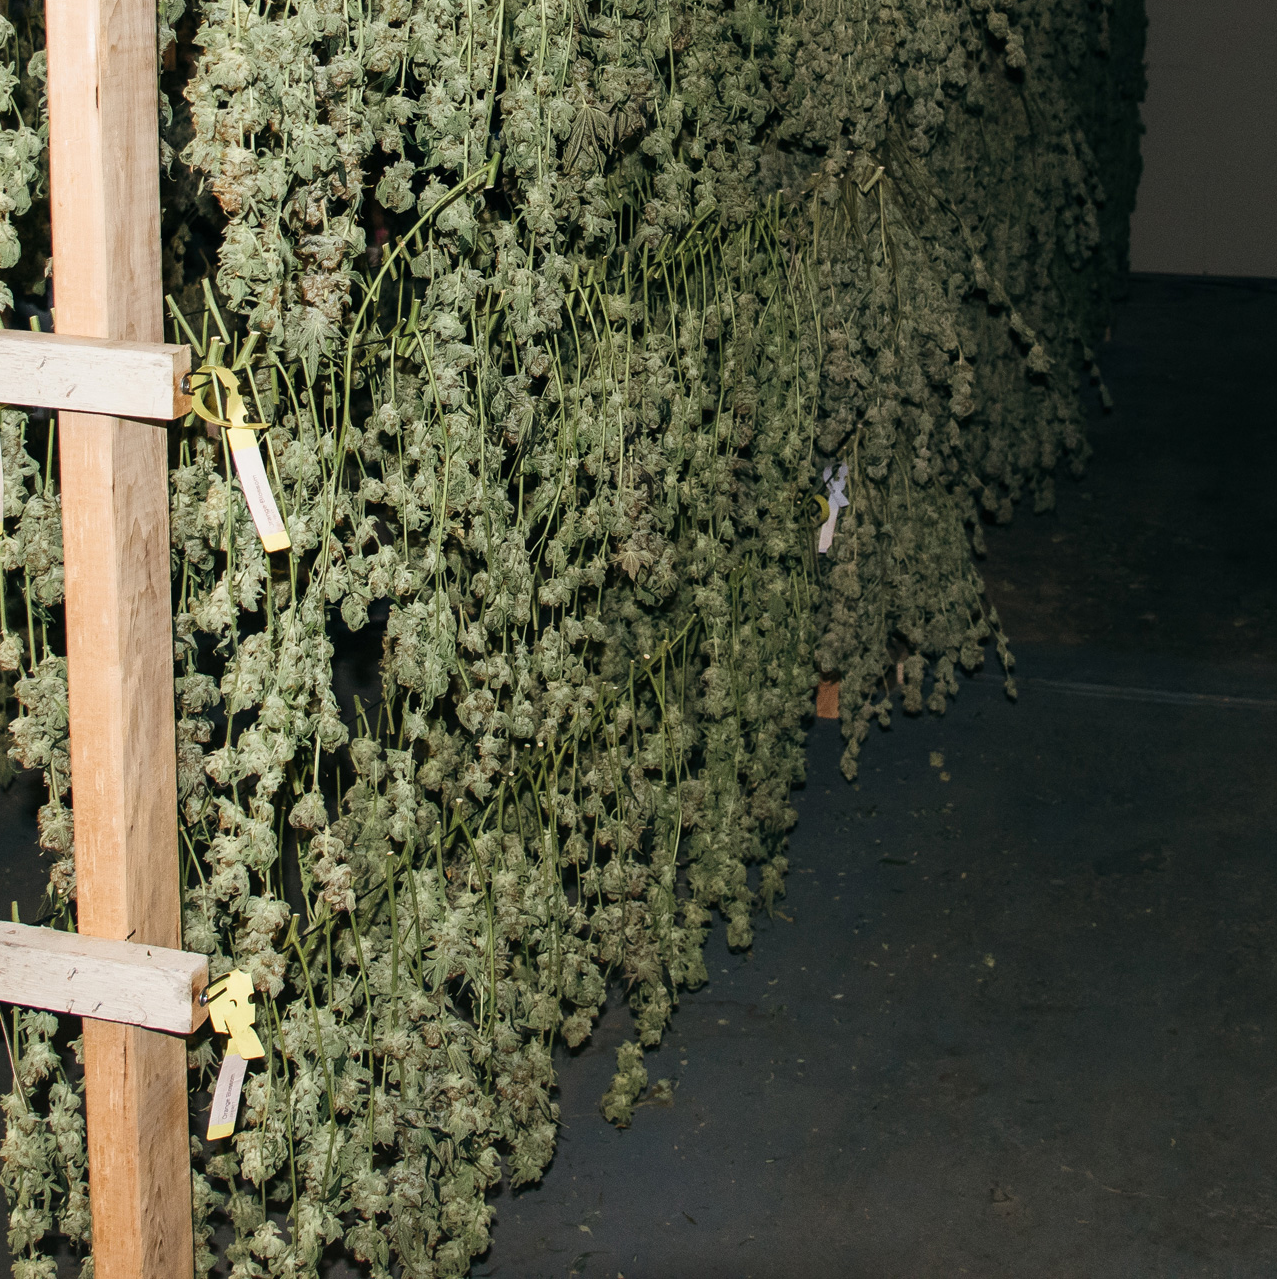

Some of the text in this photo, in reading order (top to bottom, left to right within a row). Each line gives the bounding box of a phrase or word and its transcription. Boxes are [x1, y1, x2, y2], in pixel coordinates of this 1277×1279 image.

[253, 474, 265, 504] Blossom
[225, 1073, 235, 1098] Blossom
[222, 1099, 231, 1120] Orange
